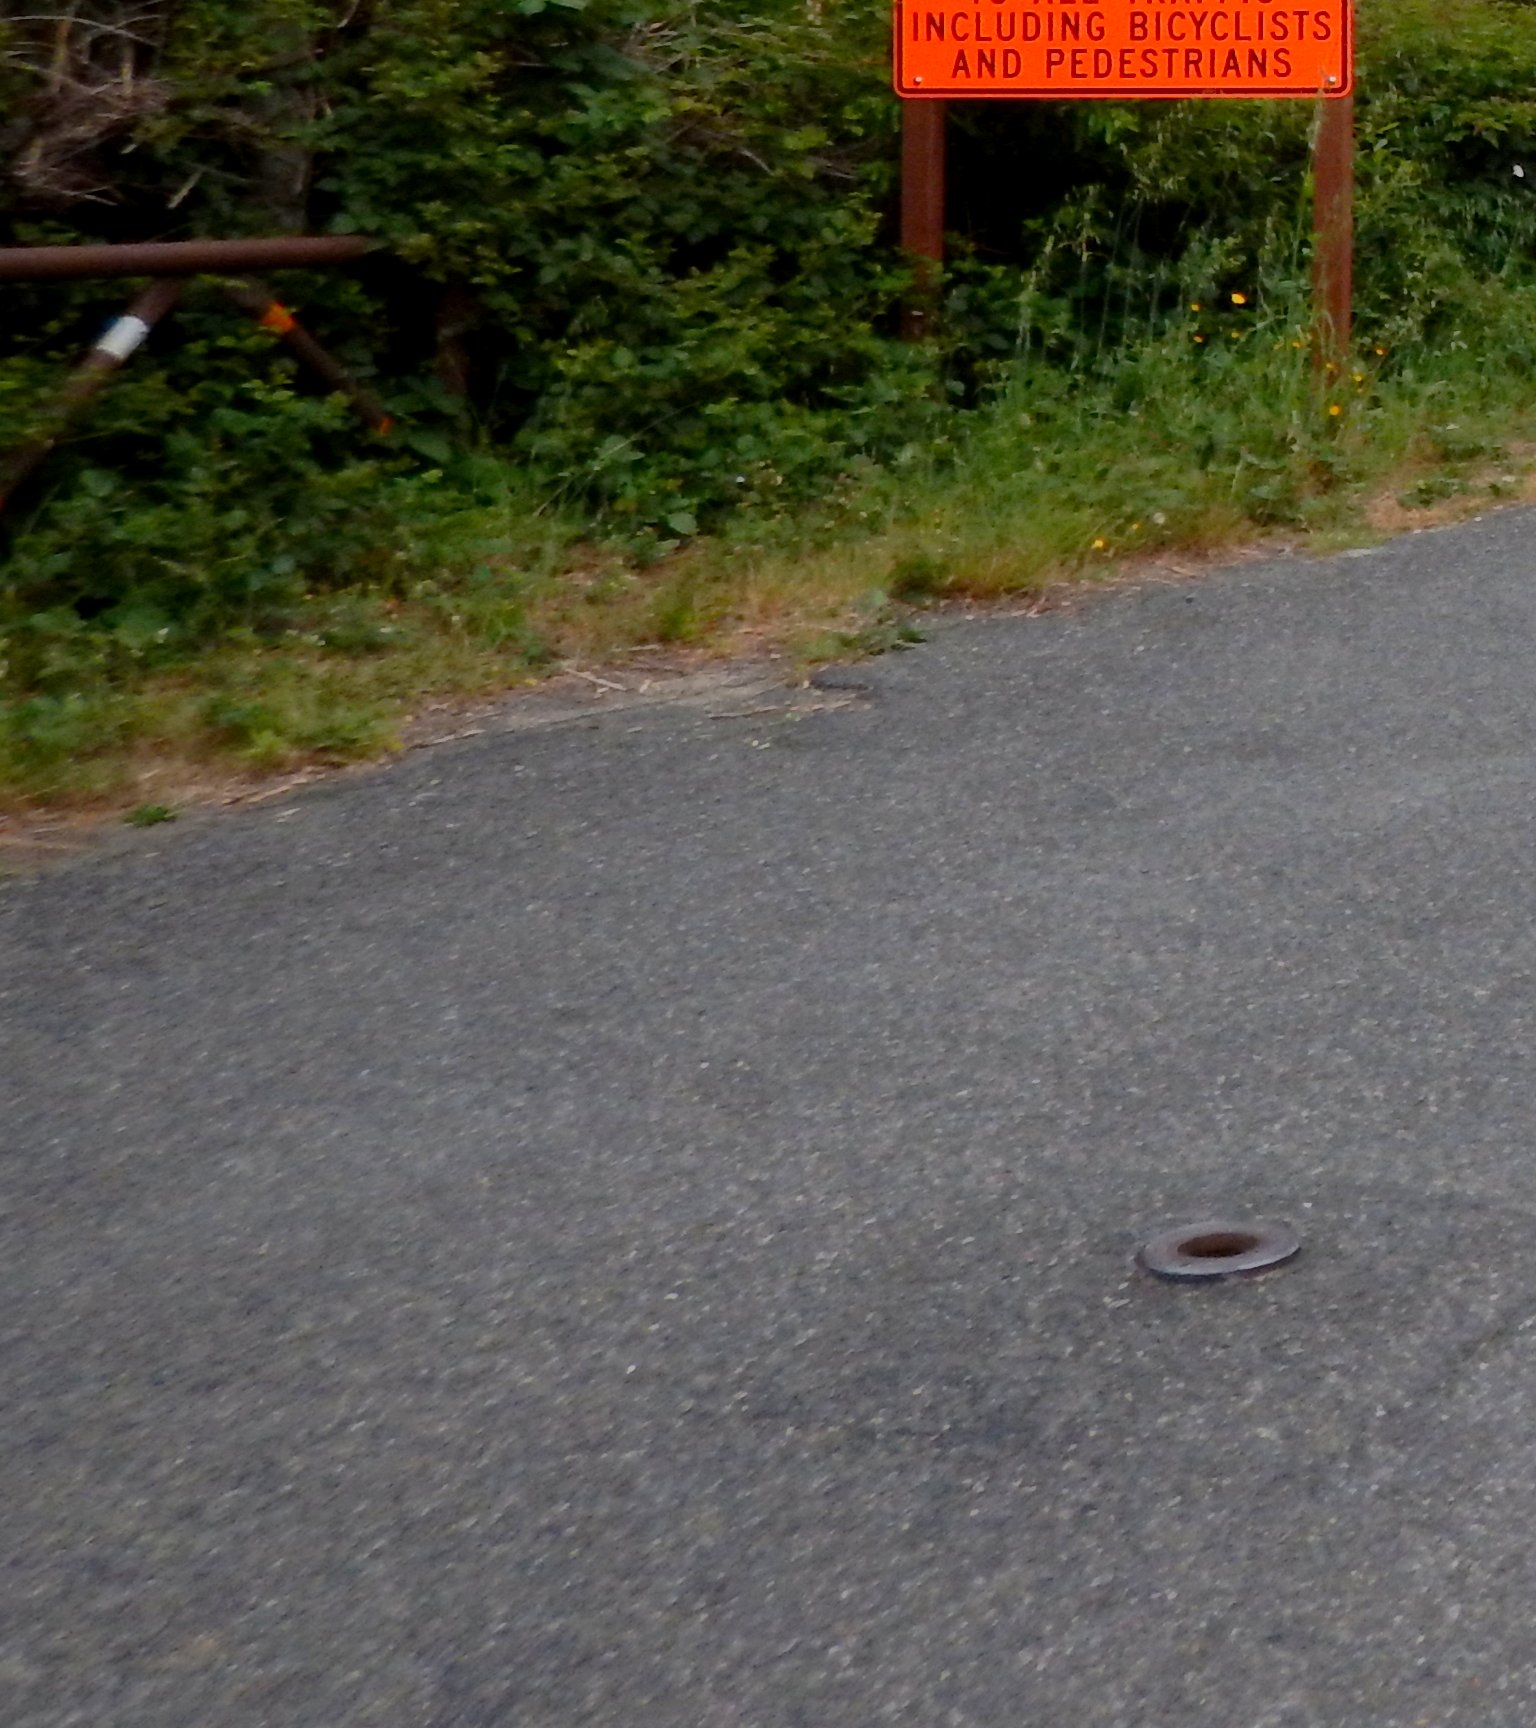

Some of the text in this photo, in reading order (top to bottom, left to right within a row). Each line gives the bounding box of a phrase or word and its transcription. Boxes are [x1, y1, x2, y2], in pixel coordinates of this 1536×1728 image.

[913, 10, 1332, 42] INCLUDING BICYCLISTS
[951, 48, 1291, 79] AND PEDESTRIANS
